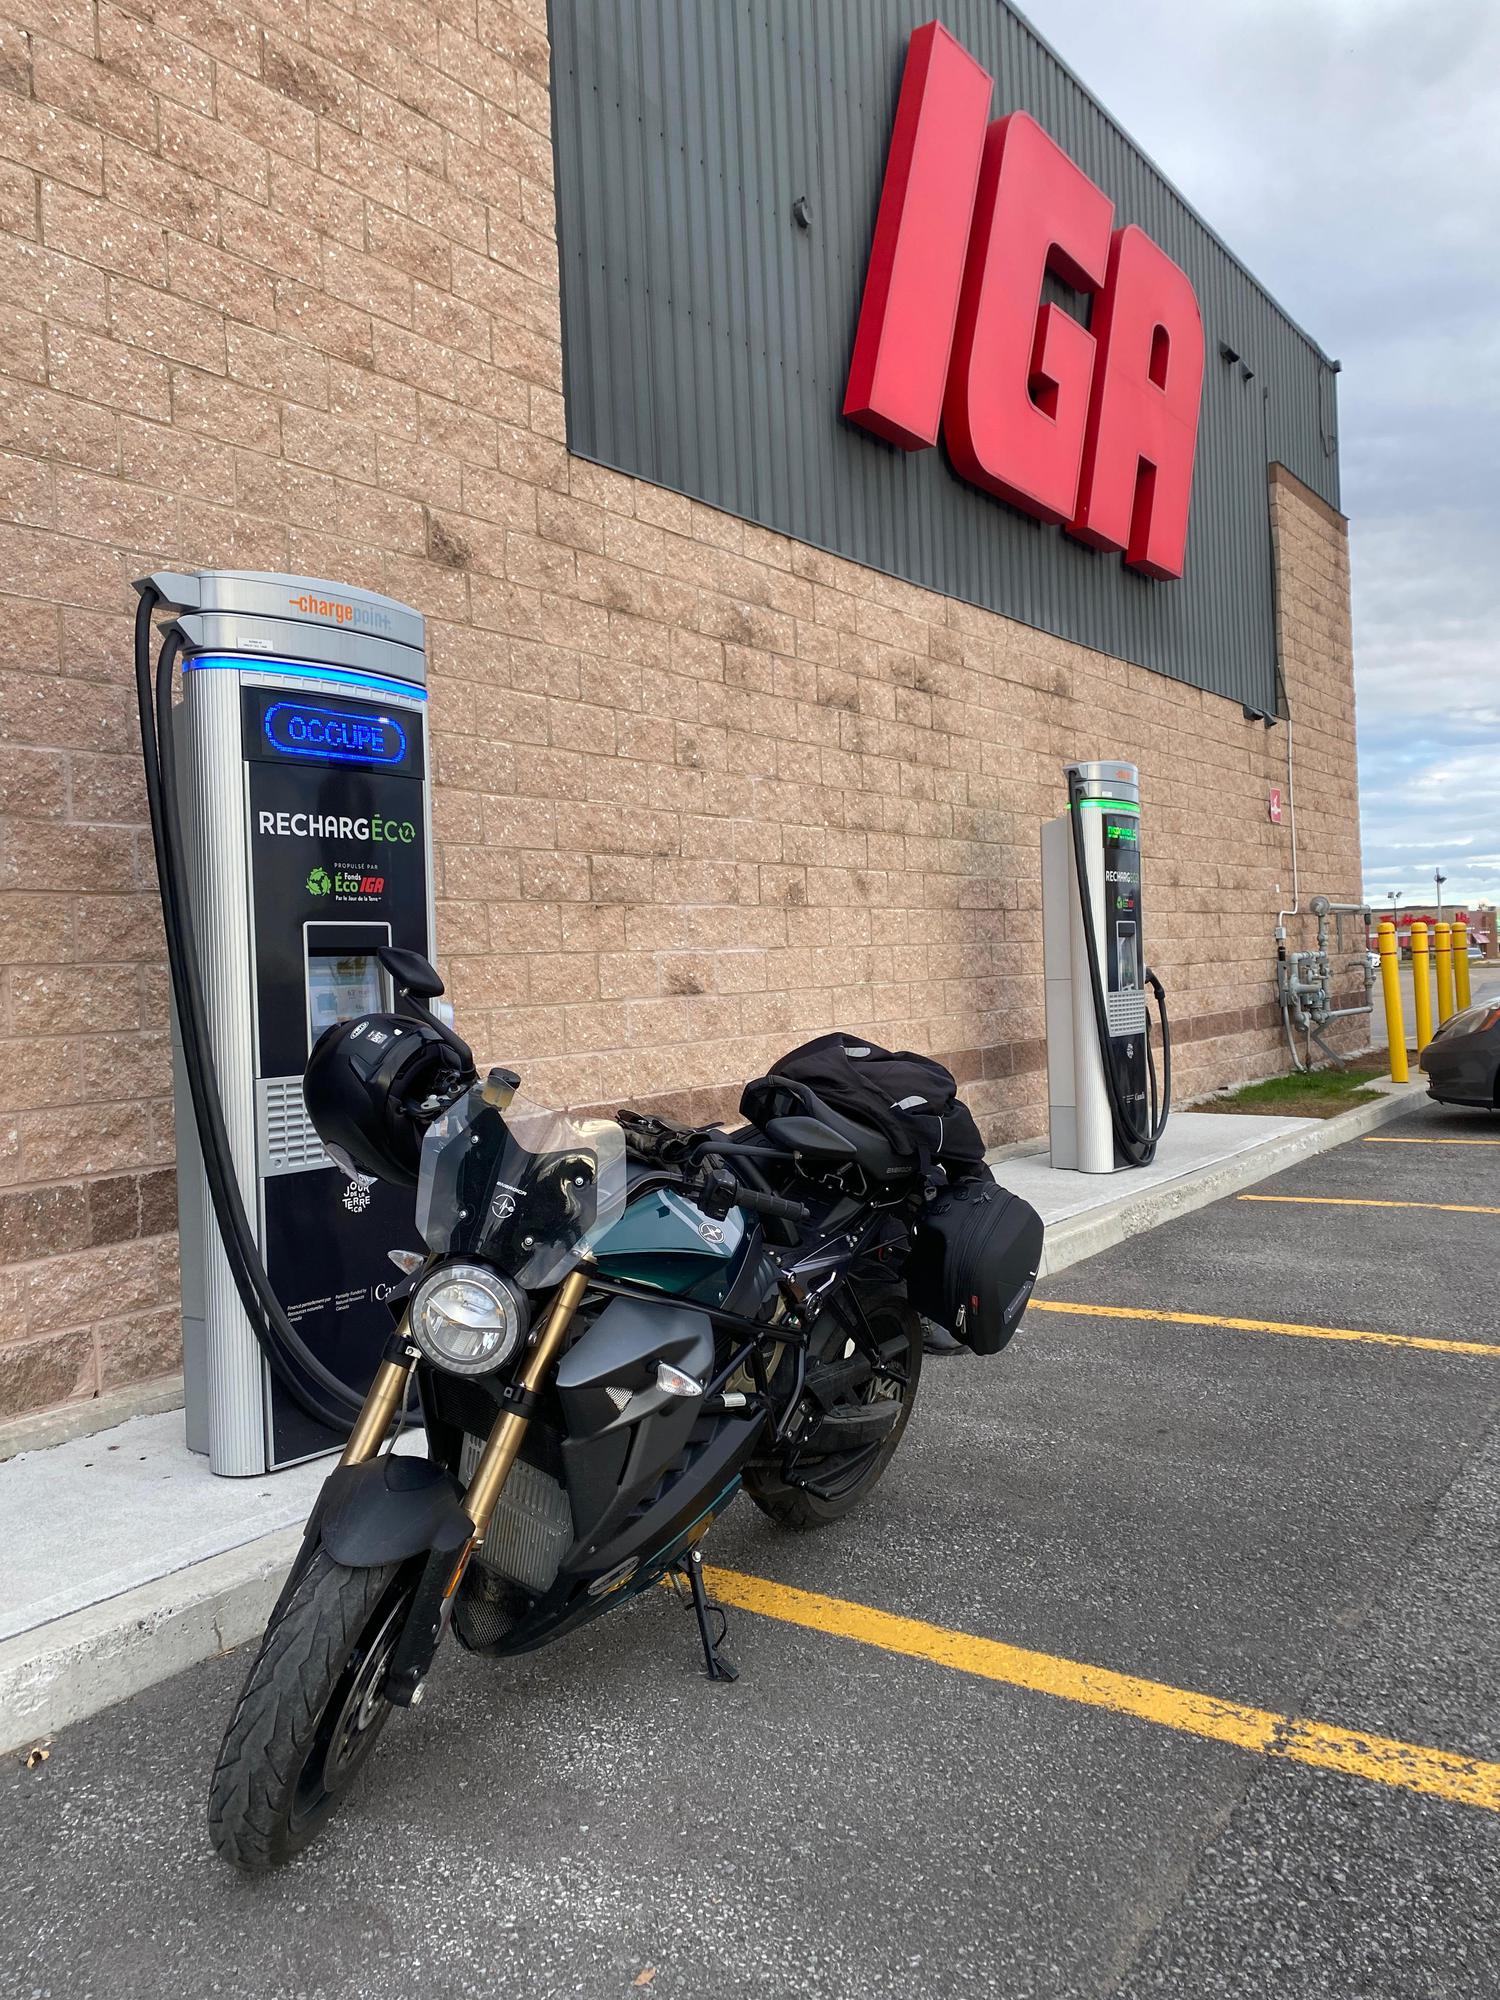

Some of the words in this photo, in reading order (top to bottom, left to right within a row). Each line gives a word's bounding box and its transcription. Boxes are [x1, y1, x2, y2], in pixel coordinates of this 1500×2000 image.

[843, 19, 1205, 582] IGA
[288, 716, 384, 752] OCCUPE
[344, 872, 361, 880] Fonds
[360, 877, 384, 893] IGA
[342, 1196, 371, 1210] TERRE
